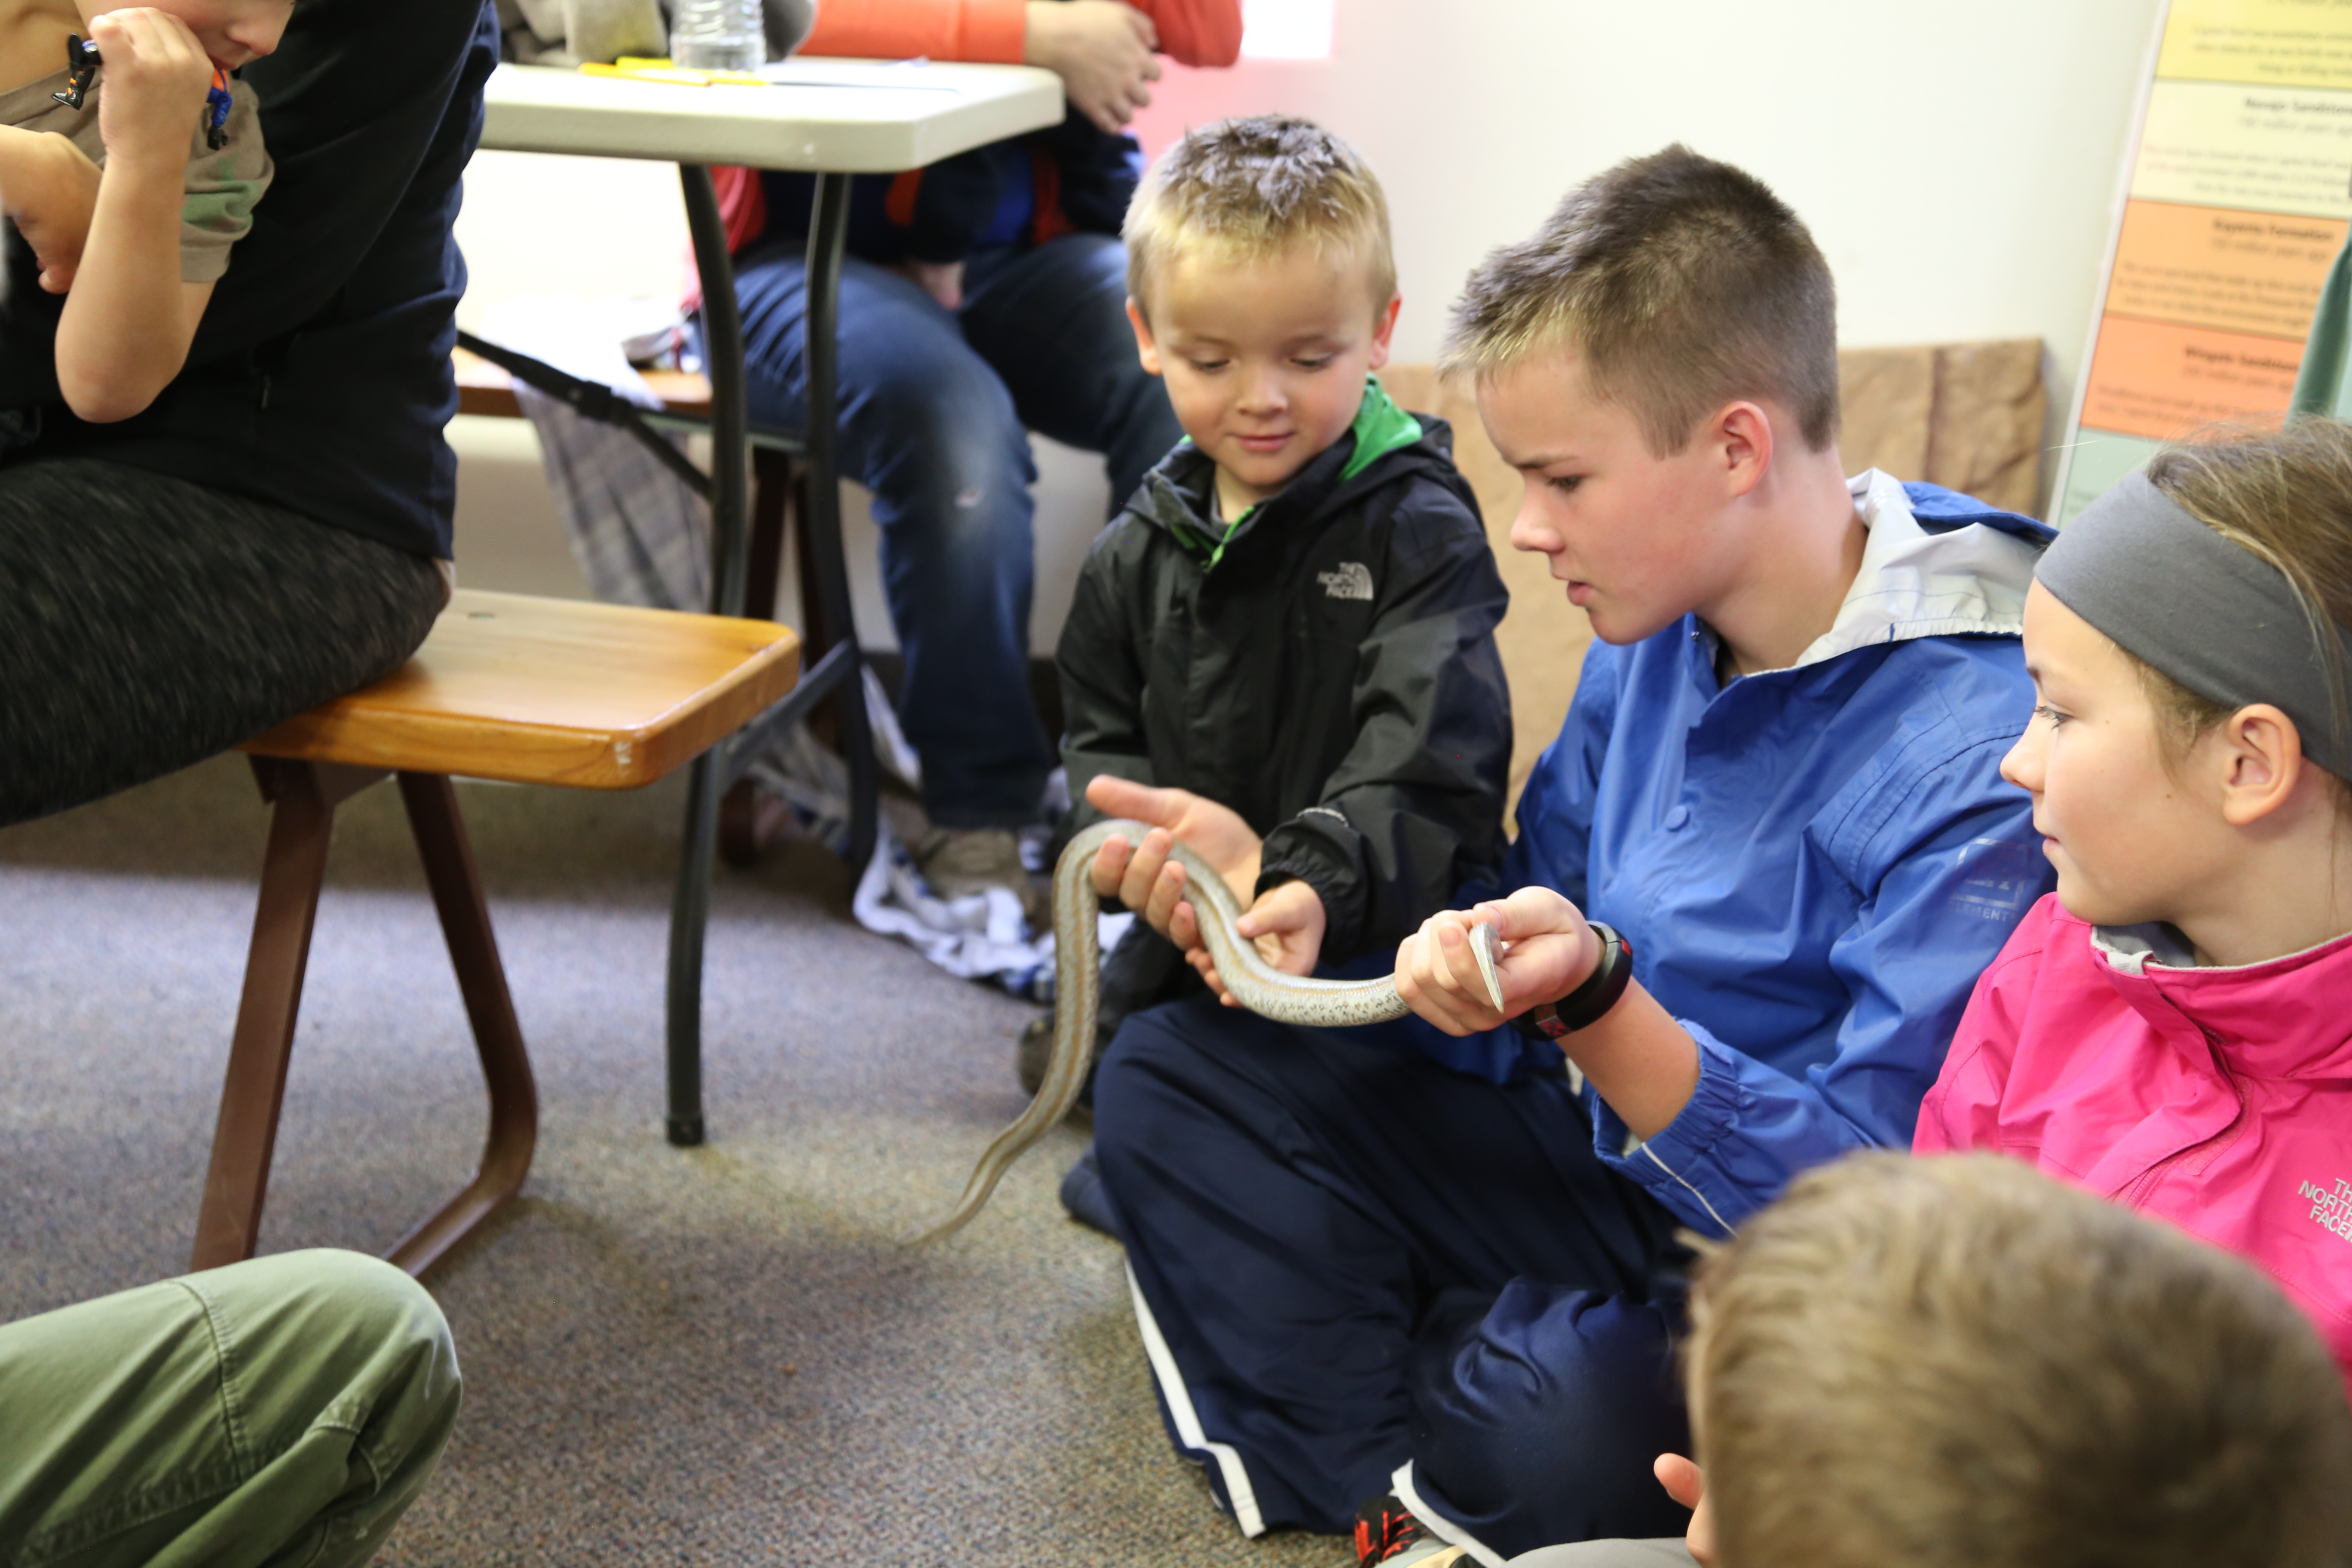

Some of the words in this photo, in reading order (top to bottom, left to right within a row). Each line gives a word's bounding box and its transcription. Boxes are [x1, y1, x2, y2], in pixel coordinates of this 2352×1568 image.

[2298, 1180, 2352, 1224] NORTH
[2335, 1178, 2352, 1207] TH
[2309, 1205, 2352, 1237] FACE
